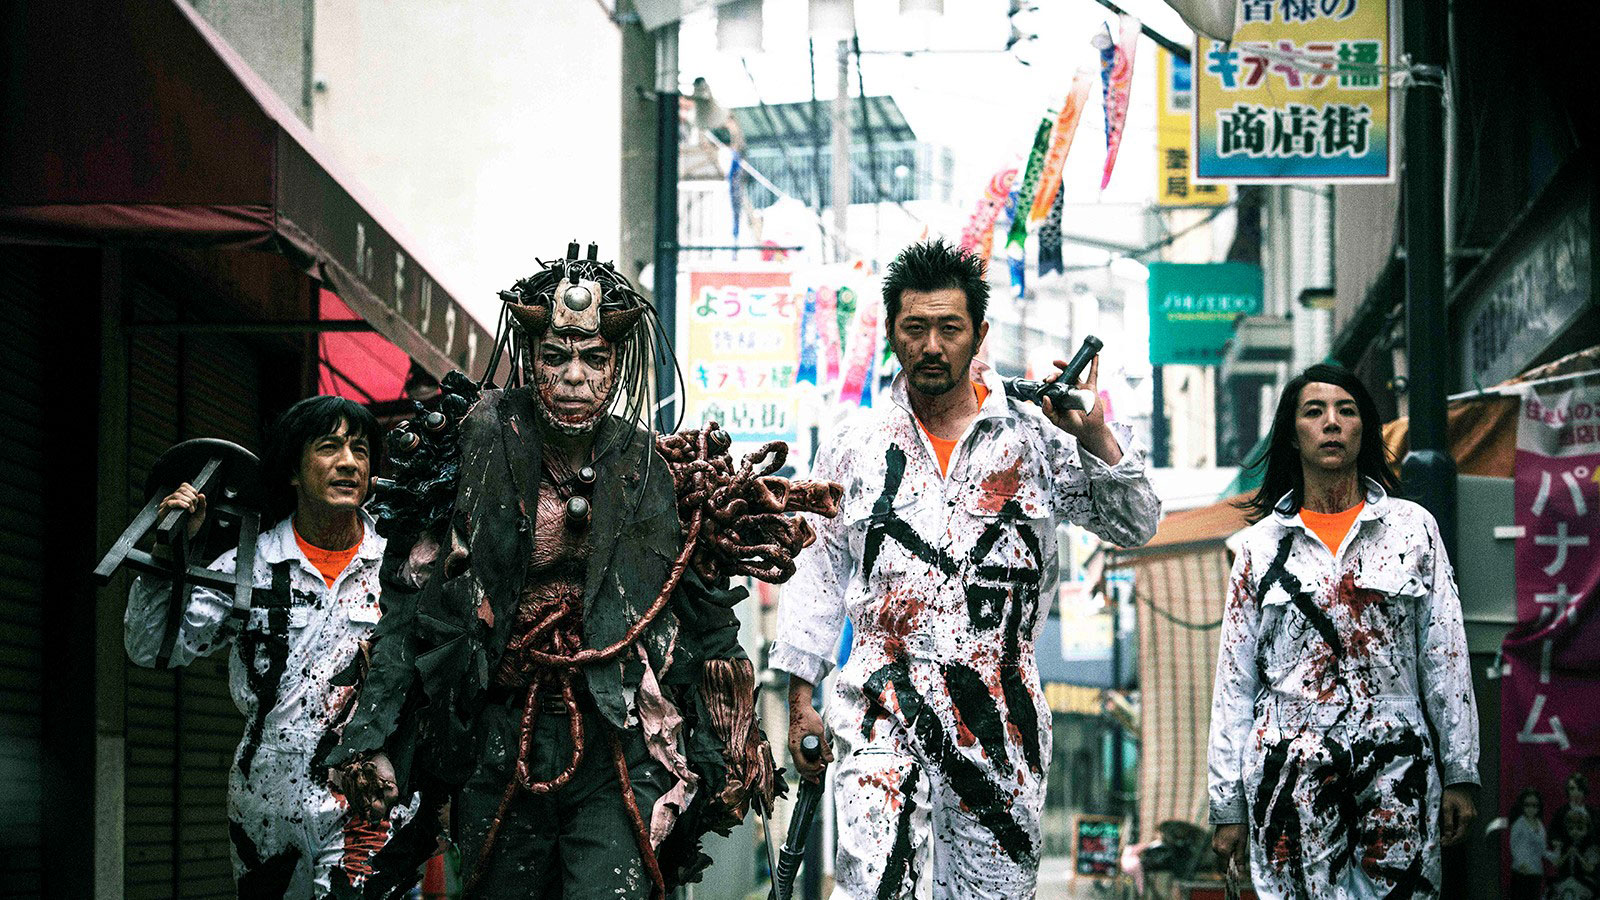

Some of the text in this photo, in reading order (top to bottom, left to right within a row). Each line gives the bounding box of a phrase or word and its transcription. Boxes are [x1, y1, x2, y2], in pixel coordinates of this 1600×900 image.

[1219, 105, 1370, 156] 商店街
[696, 291, 792, 317] ようこそ
[1517, 466, 1589, 751] パナホーム
